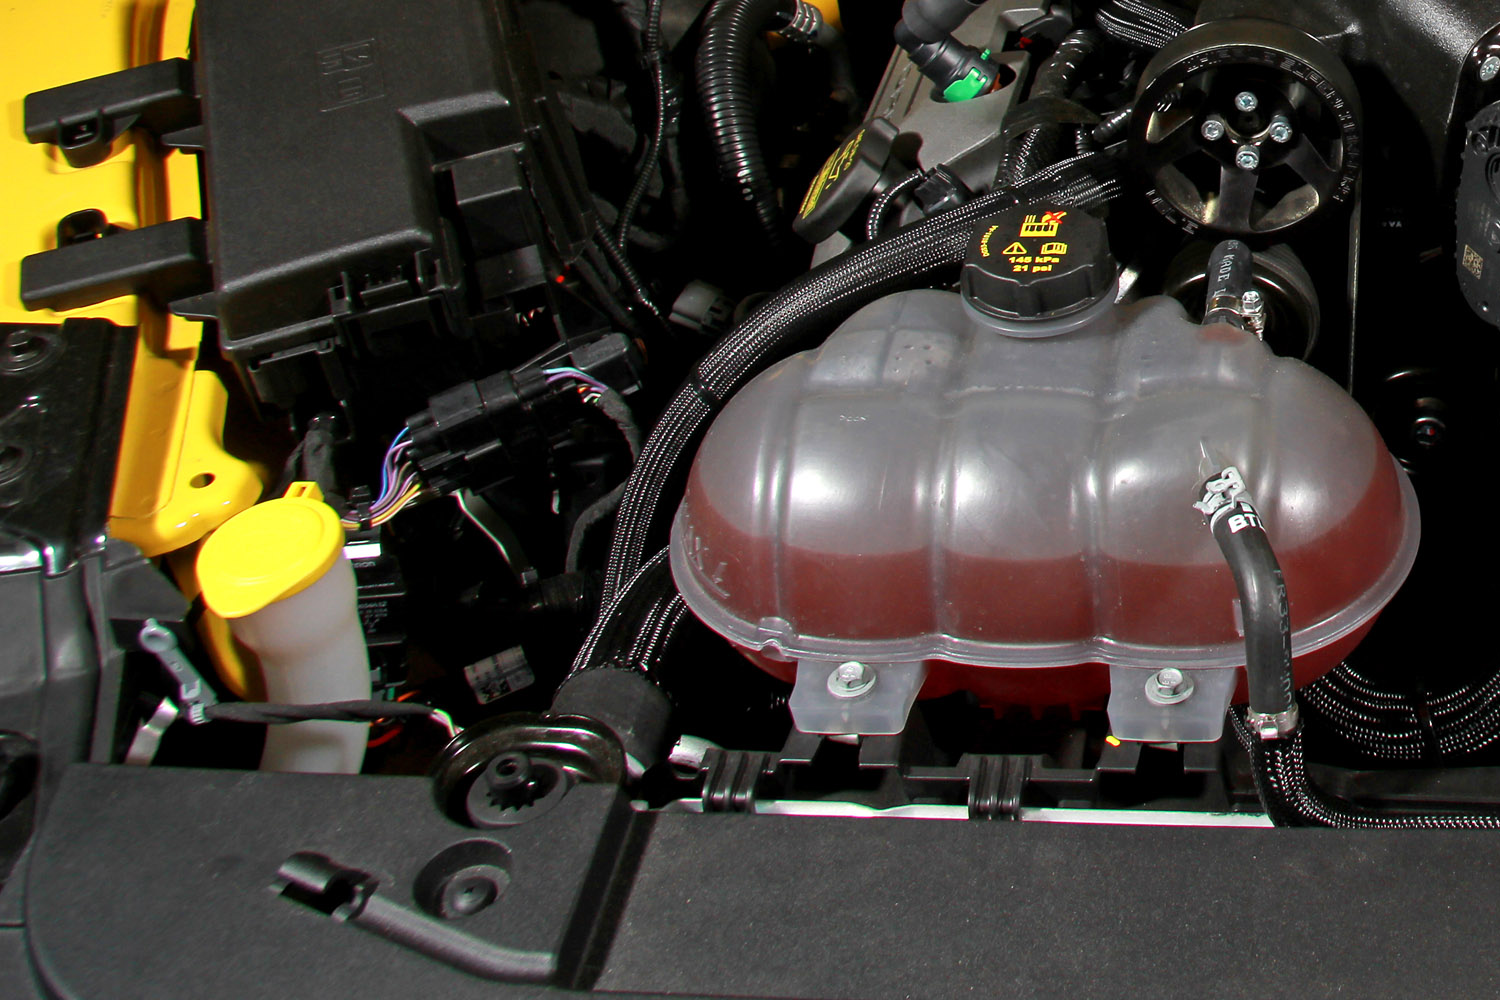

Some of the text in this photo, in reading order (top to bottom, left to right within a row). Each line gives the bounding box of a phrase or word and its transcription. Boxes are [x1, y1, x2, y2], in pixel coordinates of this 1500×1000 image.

[1008, 256, 1060, 264] 145 kPa
[1013, 264, 1052, 274] 21 psi
